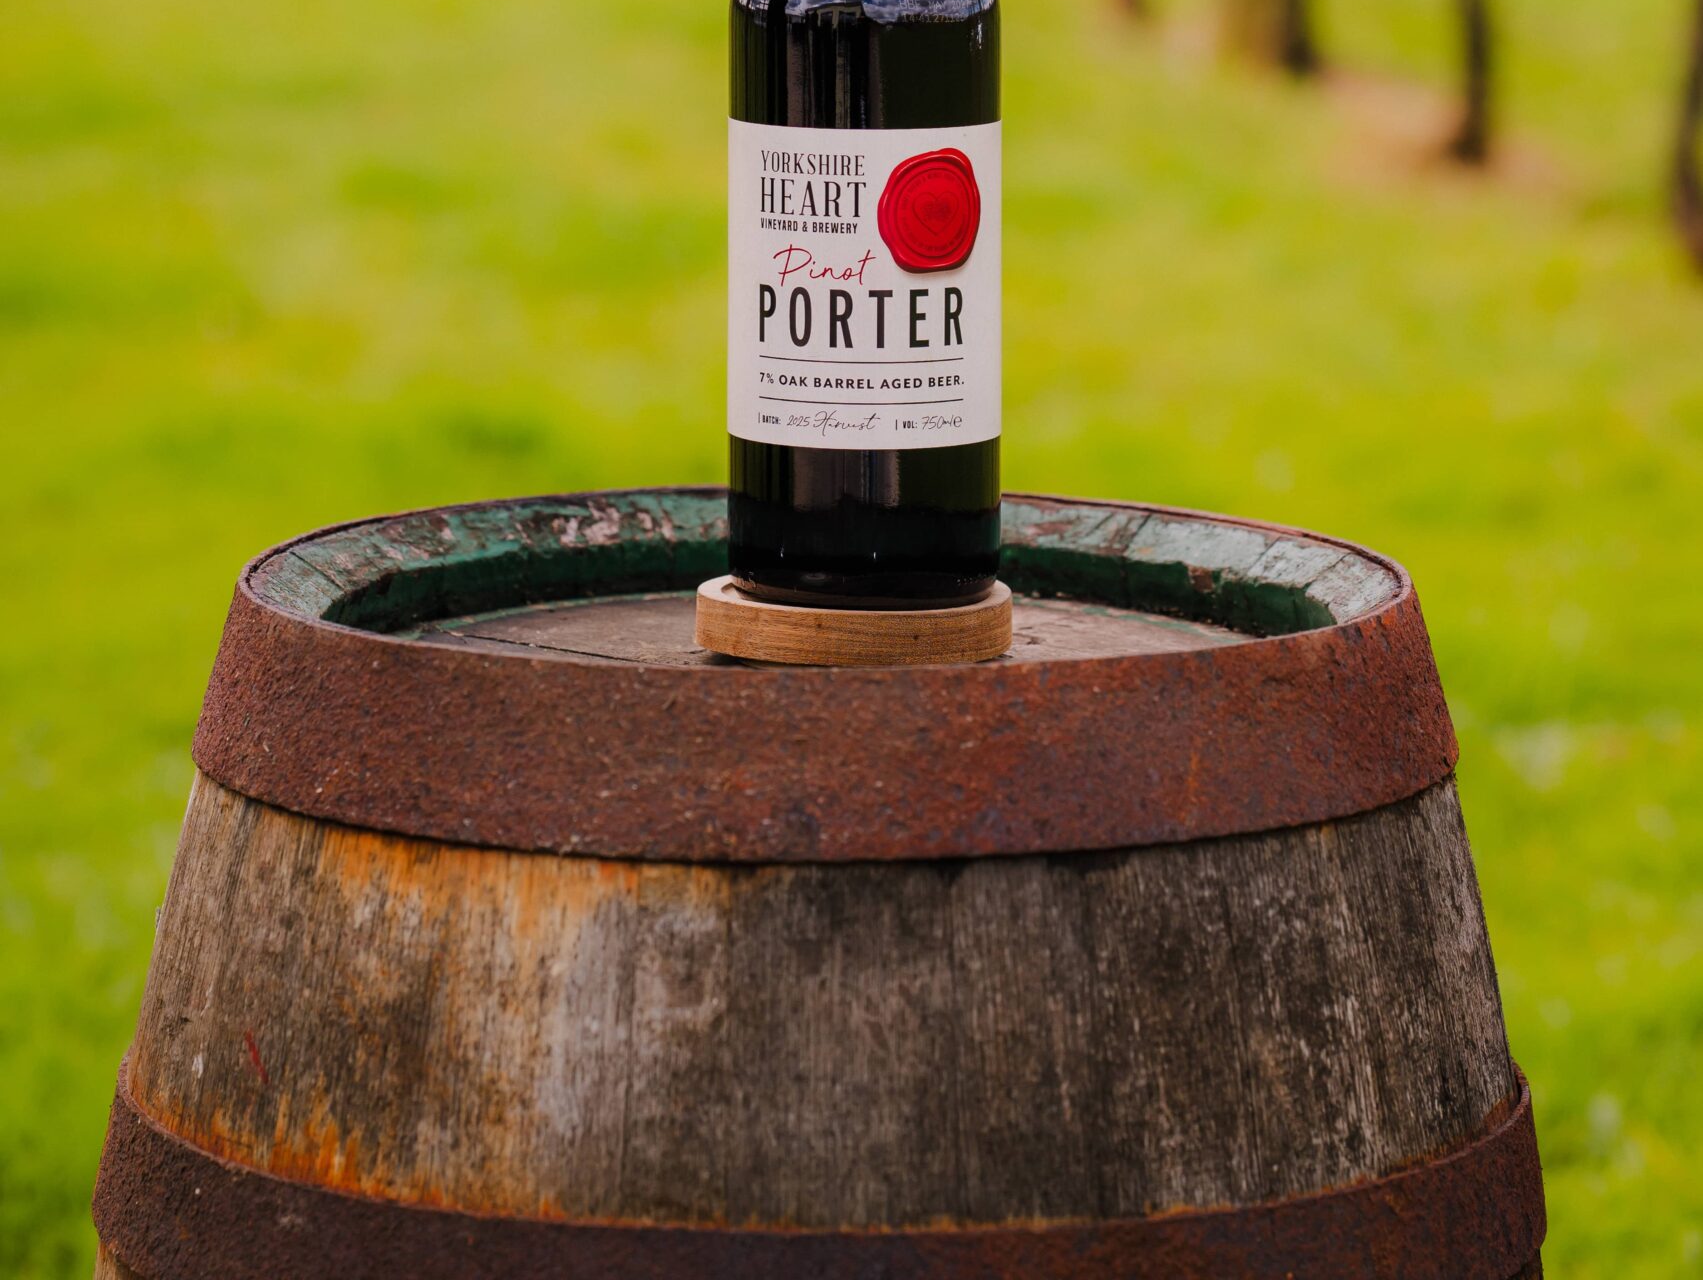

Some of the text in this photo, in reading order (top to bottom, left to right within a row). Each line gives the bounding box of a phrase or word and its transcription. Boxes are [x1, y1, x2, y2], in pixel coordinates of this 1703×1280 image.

[760, 150, 865, 177] YORKSHIRE
[760, 176, 867, 218] HEART
[760, 217, 858, 234] VINEYARD & BREWERY
[773, 244, 876, 287] Pinot
[759, 283, 963, 349] PORTER
[759, 372, 965, 389] 7% OAK BARREL AGED BEER.
[762, 413, 782, 426] BATCH:
[787, 414, 811, 428] 2025
[902, 419, 918, 430] VOL:
